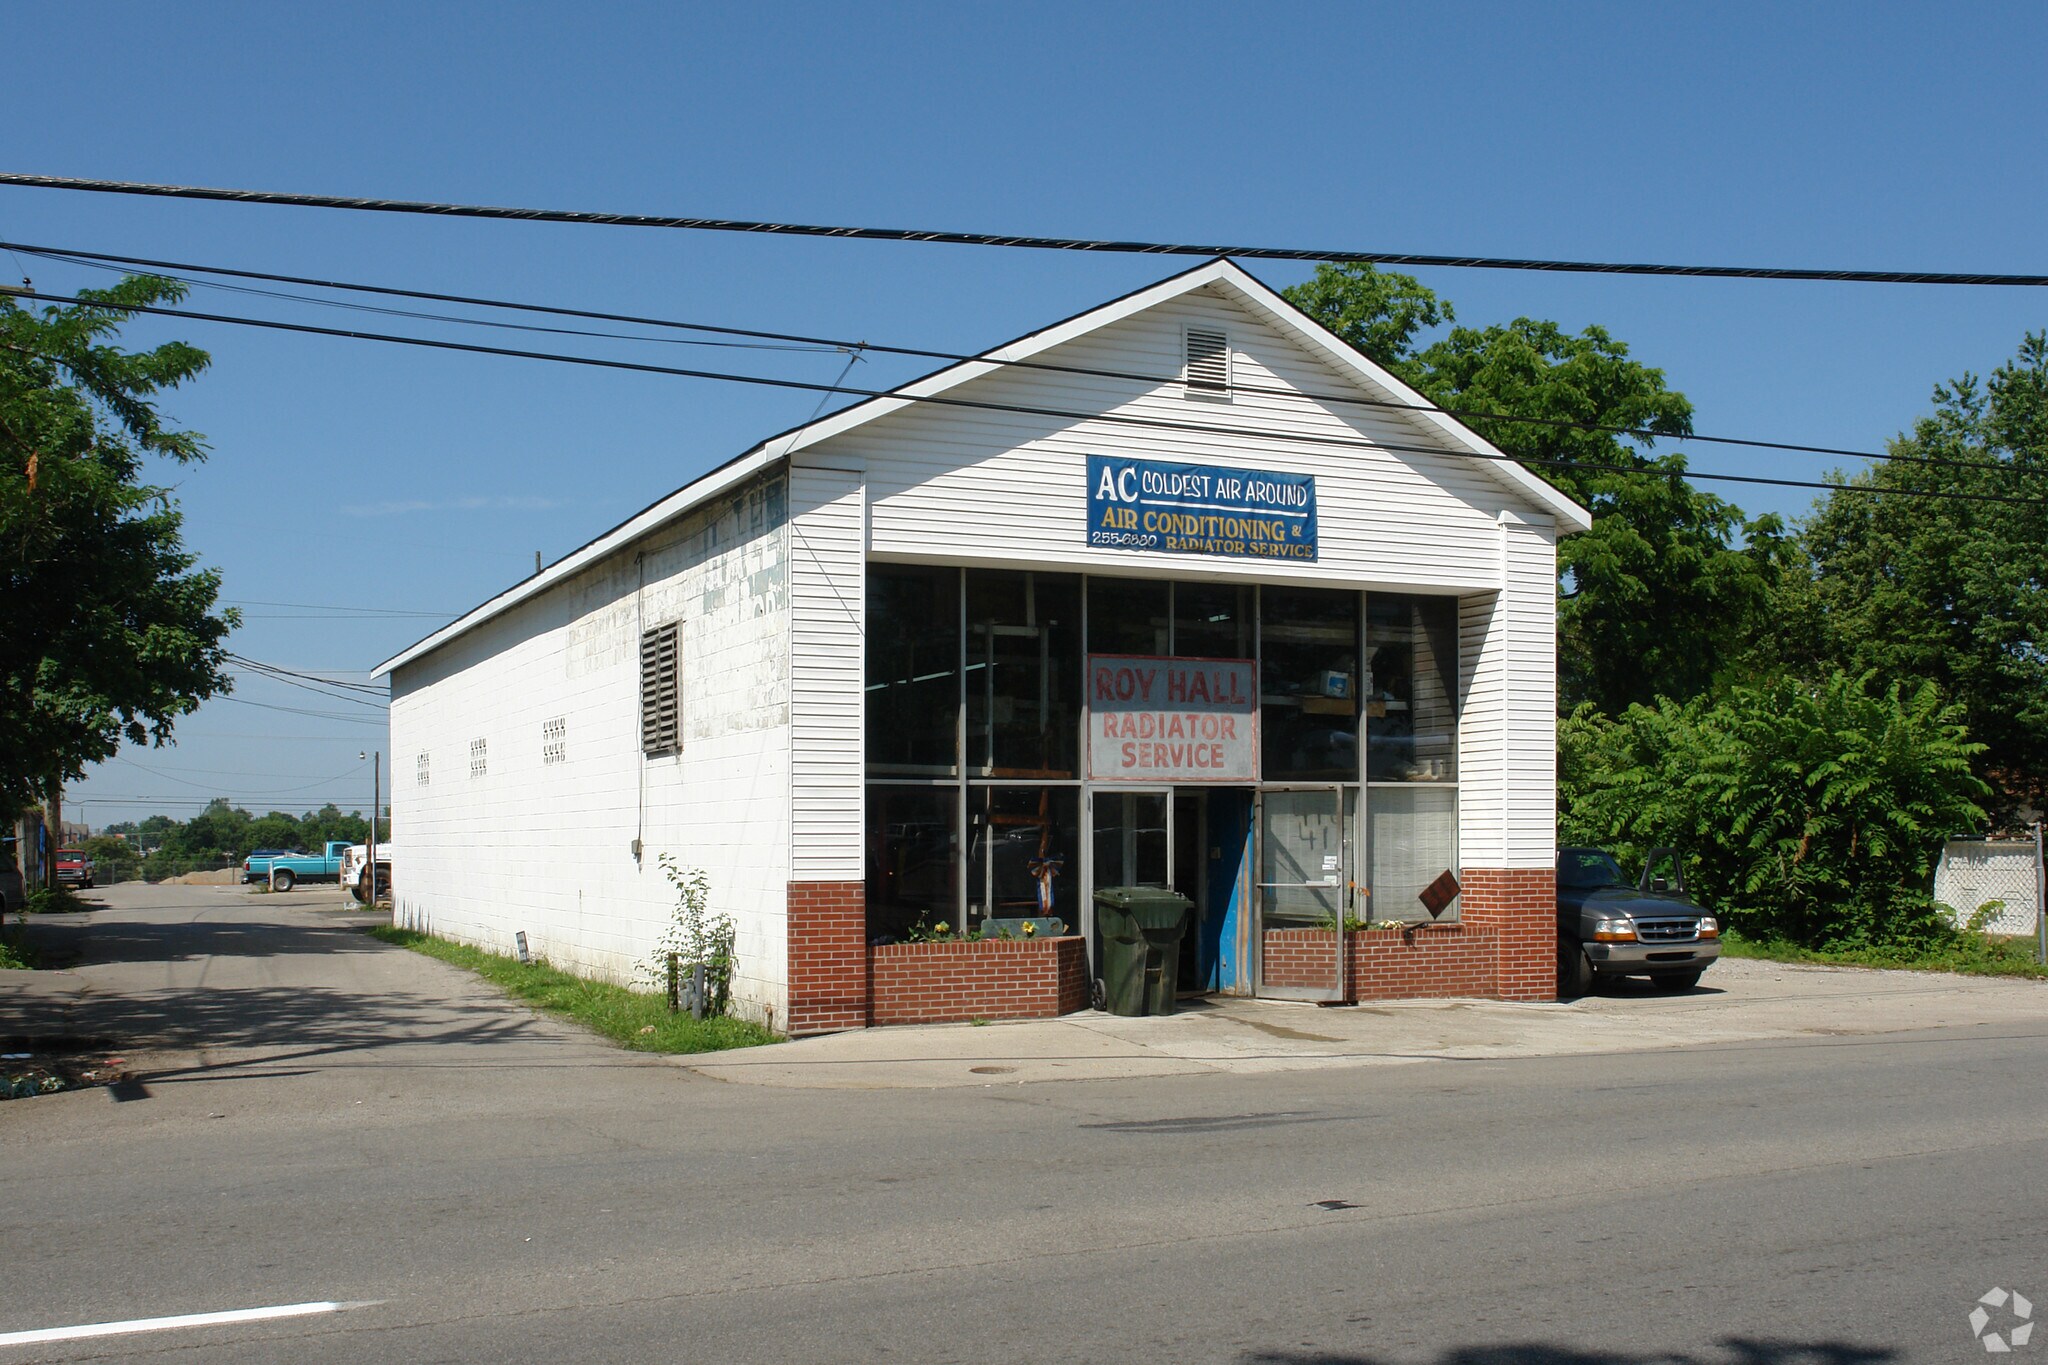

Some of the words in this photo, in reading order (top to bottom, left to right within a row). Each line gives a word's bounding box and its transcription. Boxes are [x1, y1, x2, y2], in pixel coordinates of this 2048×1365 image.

[1095, 465, 1139, 503] AC
[1142, 470, 1211, 498] COLDEST
[1215, 478, 1241, 500] AIR
[1245, 480, 1307, 507] AROUND
[1101, 506, 1138, 530] AIR
[1143, 511, 1286, 542] CONDITIONING
[1291, 524, 1302, 537] &
[1092, 531, 1157, 547] 255-6880
[1165, 535, 1245, 554] RADIATOR
[1248, 541, 1313, 558] SERVICE
[1095, 667, 1156, 701] ROY
[1167, 669, 1246, 705] HALL
[1103, 712, 1237, 740] RADIATOR
[1121, 741, 1225, 768] SERVICE
